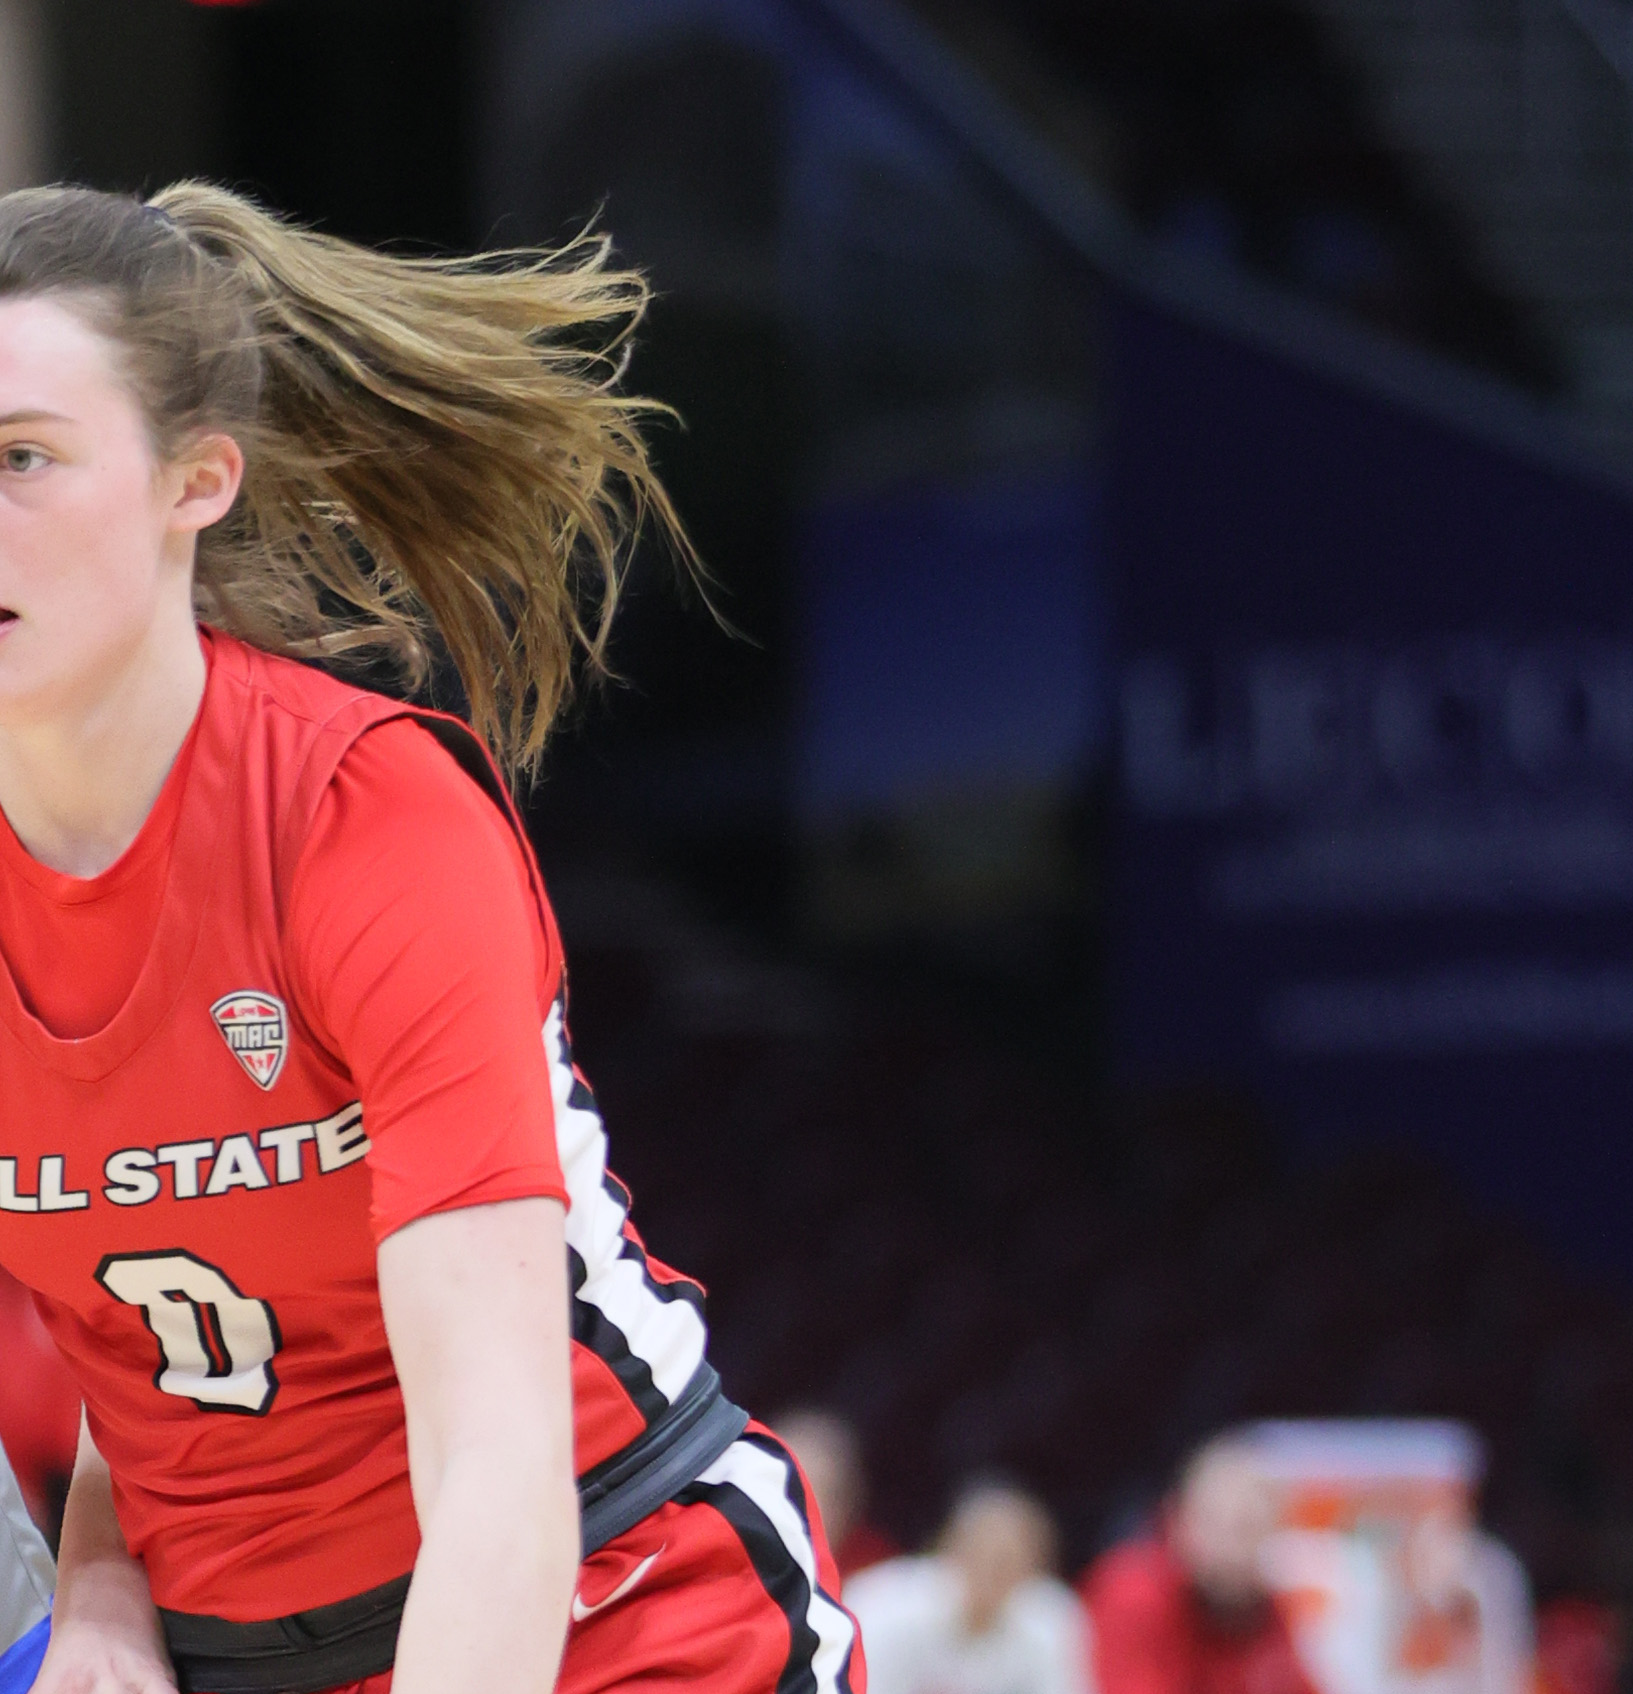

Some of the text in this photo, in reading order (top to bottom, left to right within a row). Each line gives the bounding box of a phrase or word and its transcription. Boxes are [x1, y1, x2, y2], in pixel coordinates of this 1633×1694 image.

[223, 1023, 284, 1049] MAC
[103, 1100, 372, 1207] STATE
[93, 1247, 283, 1418] 0
